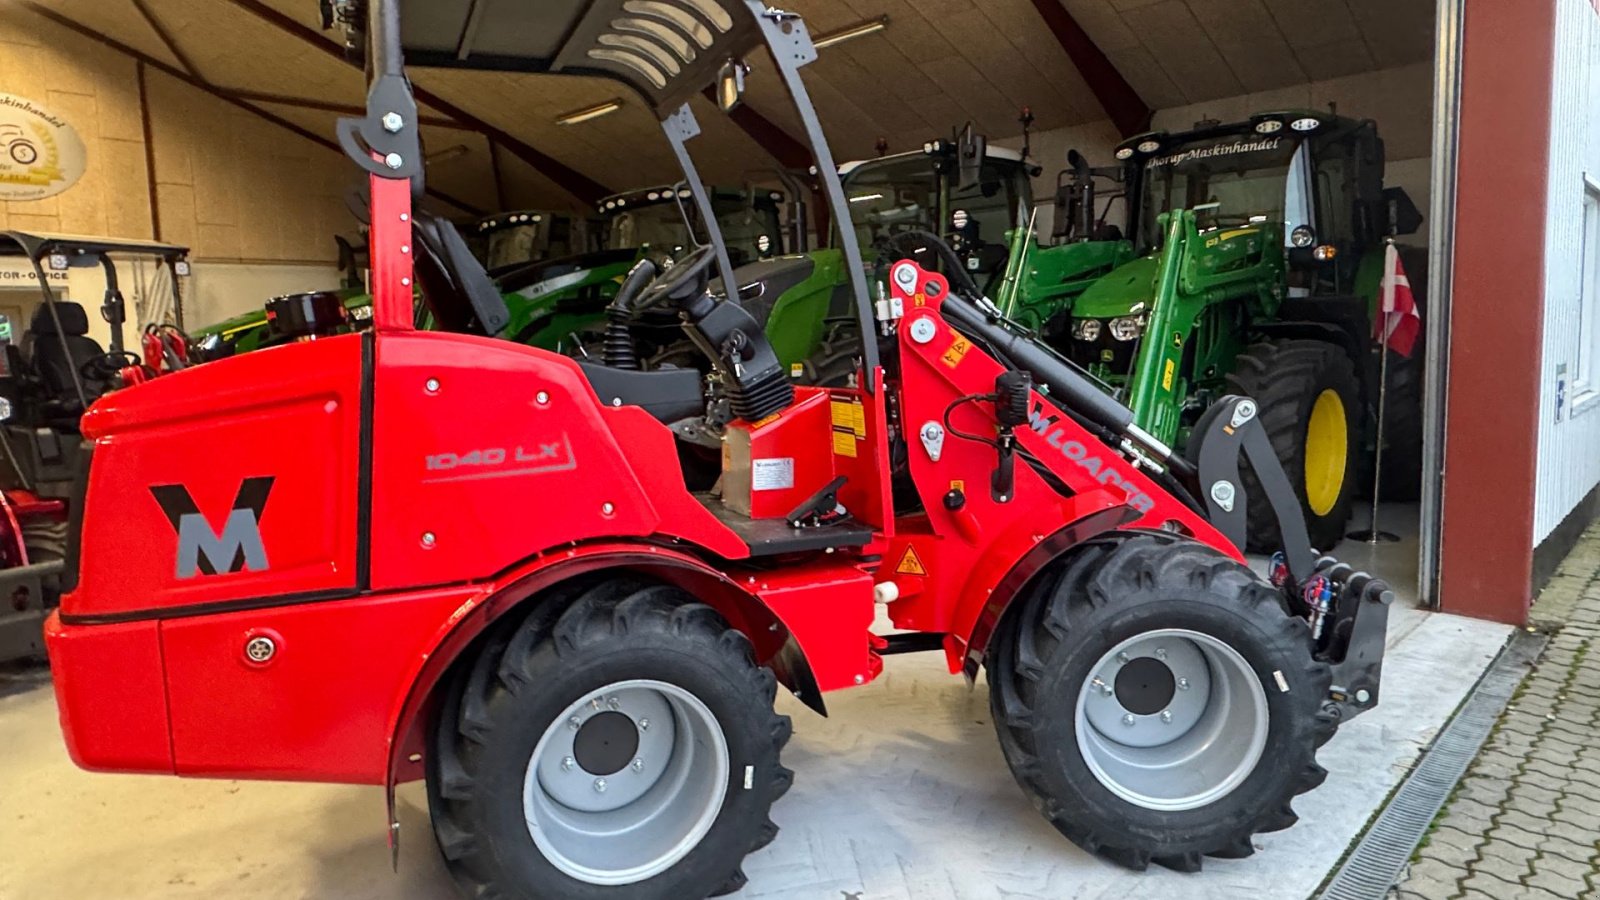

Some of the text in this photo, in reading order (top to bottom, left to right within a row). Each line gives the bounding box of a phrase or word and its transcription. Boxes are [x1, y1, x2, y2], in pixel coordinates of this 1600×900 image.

[1187, 137, 1281, 160] Maskinhandel
[425, 442, 560, 470] 1040 LX
